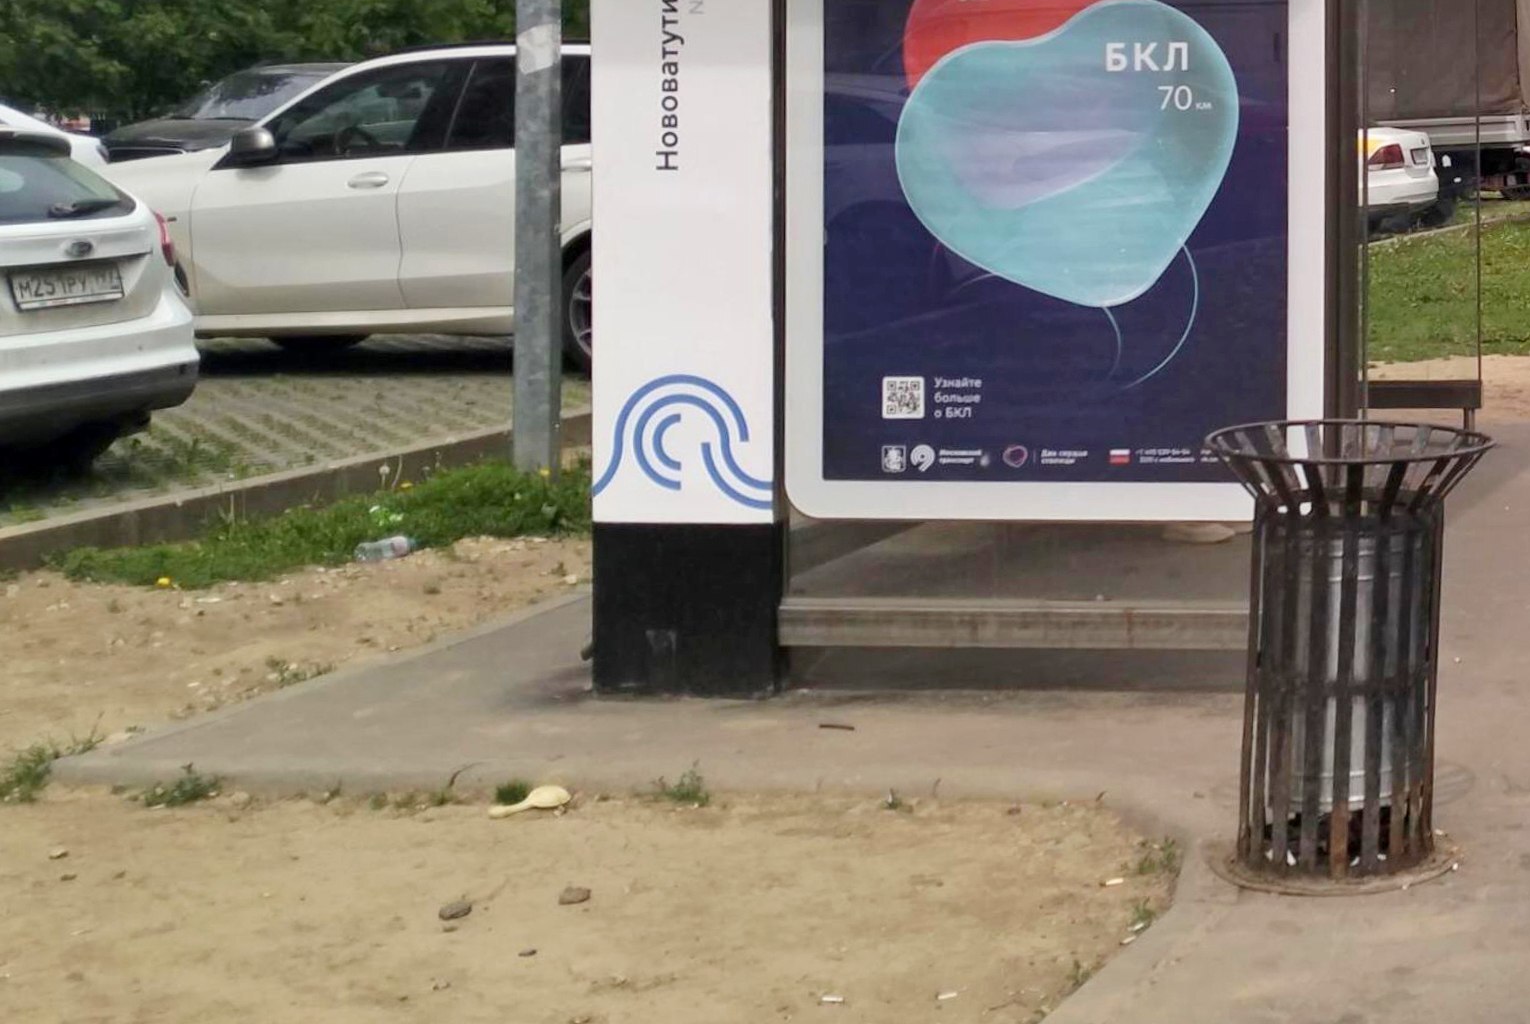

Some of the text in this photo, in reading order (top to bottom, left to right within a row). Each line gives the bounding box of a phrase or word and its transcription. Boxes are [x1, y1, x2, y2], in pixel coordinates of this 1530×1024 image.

[1105, 41, 1189, 72] БКЛ
[1157, 84, 1193, 111] 70
[934, 376, 982, 389] Узнайте
[934, 391, 981, 404] больше
[934, 406, 972, 419] о БКЛ
